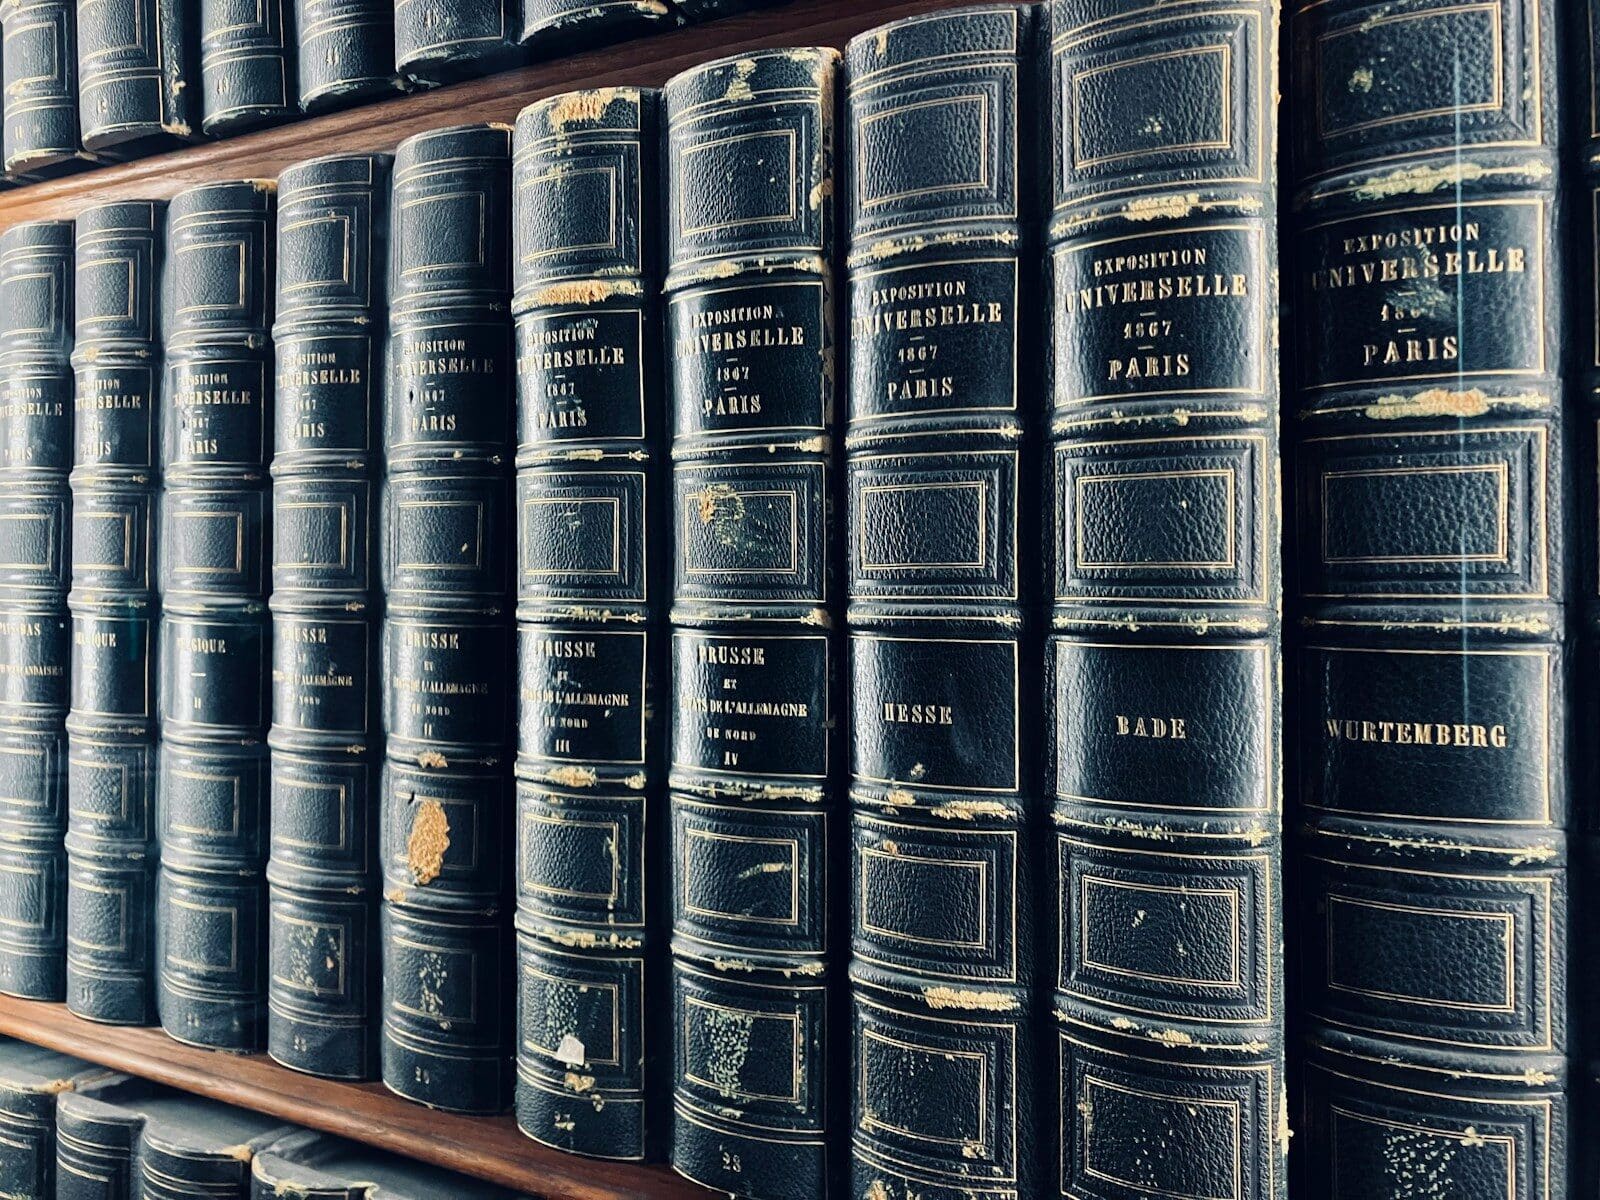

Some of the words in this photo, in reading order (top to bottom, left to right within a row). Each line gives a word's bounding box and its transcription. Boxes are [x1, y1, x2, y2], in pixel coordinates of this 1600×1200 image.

[1343, 222, 1480, 255] EXPOSITION
[1094, 248, 1206, 277] EXPOSITION
[872, 281, 966, 307] EXPOSITION
[1065, 274, 1249, 313] UNIVERSELLE
[1123, 320, 1172, 339] 1867
[898, 345, 938, 363] 1867
[1363, 336, 1458, 366] PARIS
[1108, 354, 1191, 381] PARIS
[887, 376, 953, 401] PARIS
[703, 394, 762, 418] PARIS
[538, 409, 588, 429] PARIS
[184, 439, 218, 455] ARIS
[698, 645, 765, 665] PRUSSE
[884, 702, 953, 725] HESSE
[725, 729, 757, 741] NORD
[1115, 714, 1187, 739] BADE
[1325, 718, 1507, 748] WURTEMBERG
[724, 751, 739, 765] IV
[722, 1152, 741, 1172] 28
